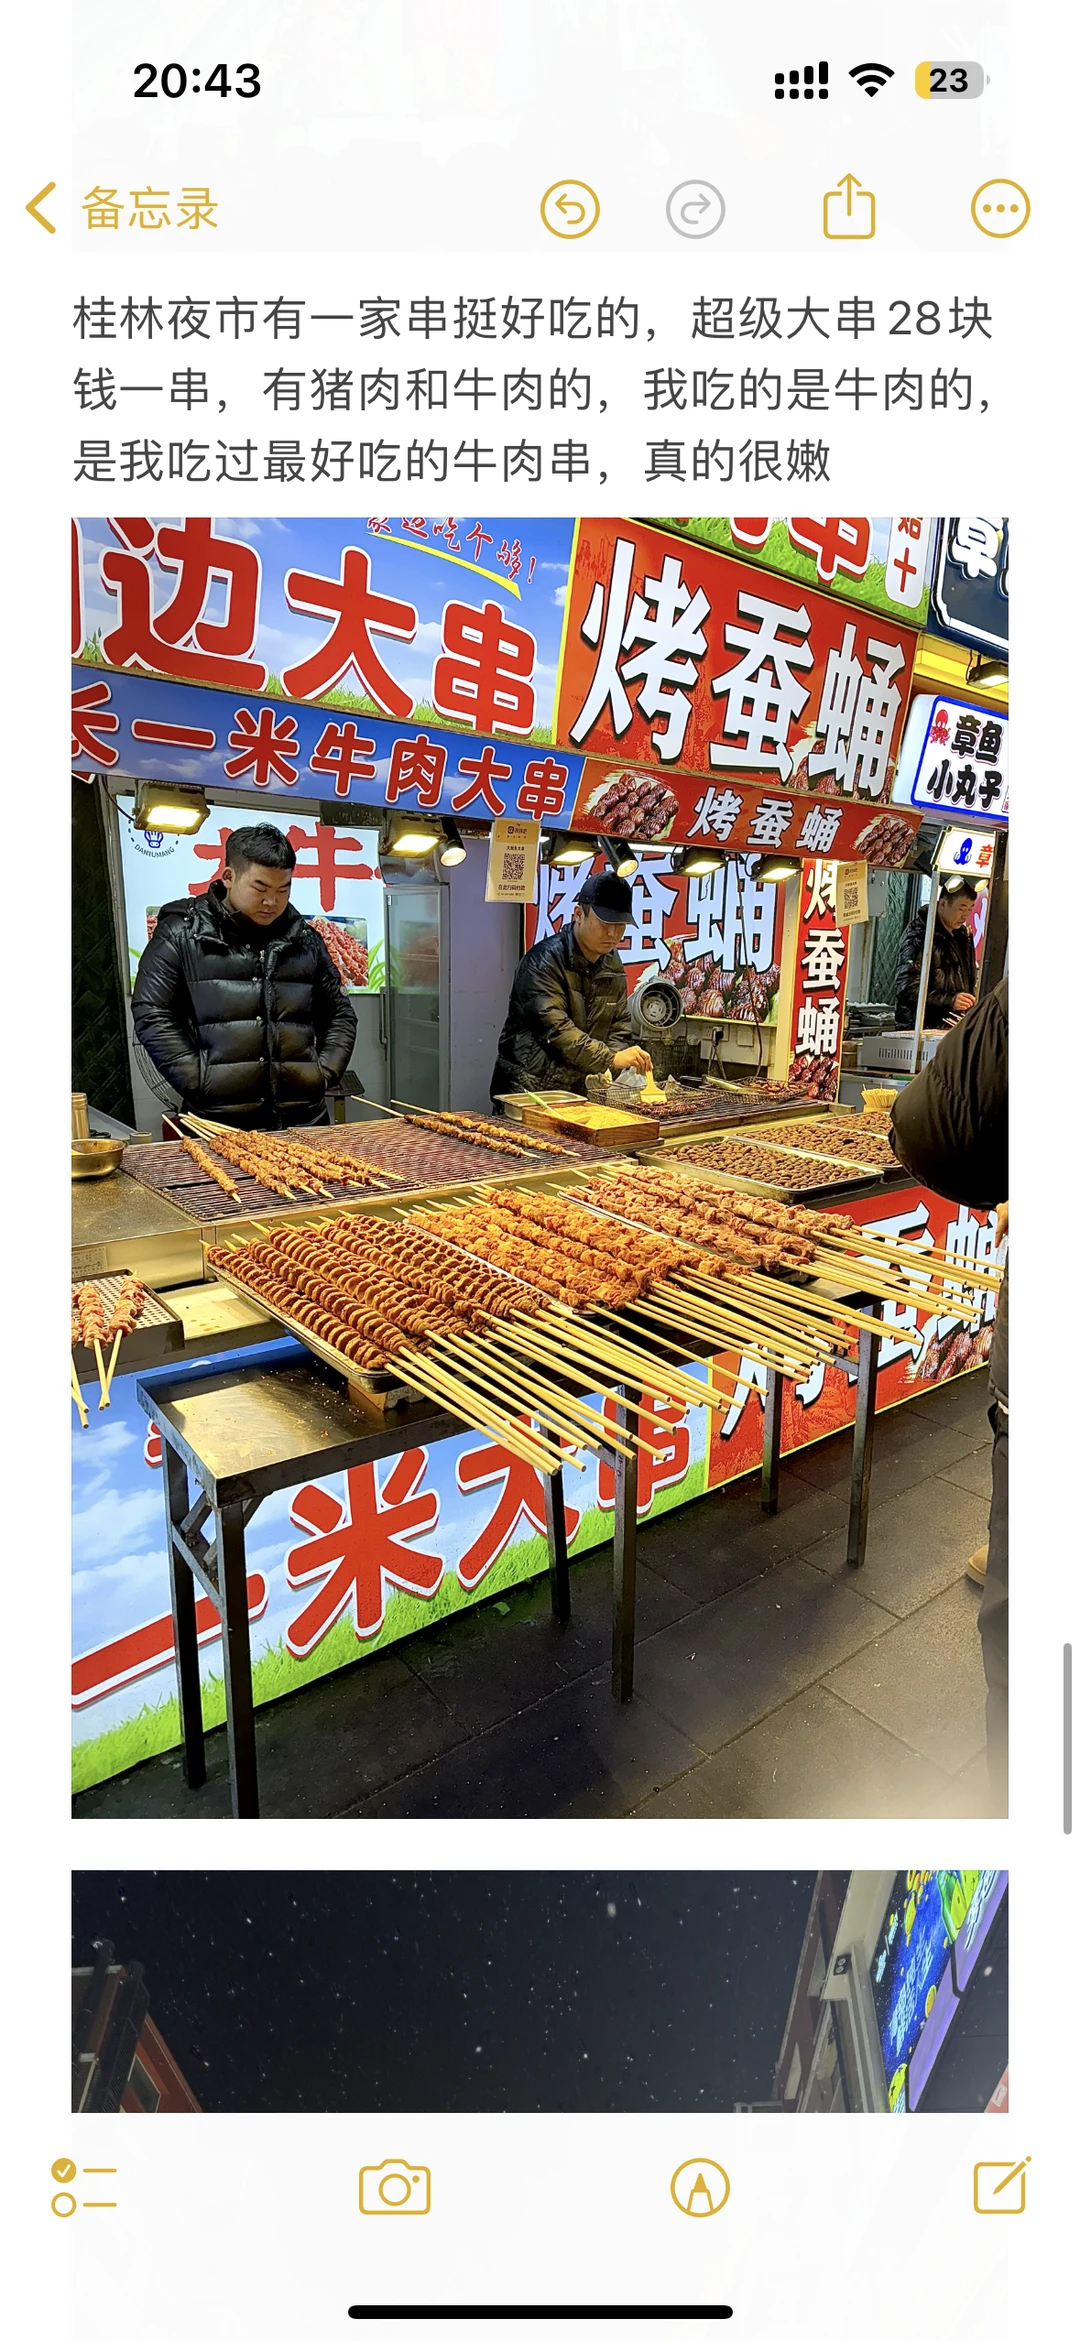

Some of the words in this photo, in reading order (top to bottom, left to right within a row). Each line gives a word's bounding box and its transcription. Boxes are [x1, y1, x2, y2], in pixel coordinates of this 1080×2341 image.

[71, 517, 537, 736] 边大串
[570, 537, 906, 798] 烤蚕蛹
[951, 714, 1003, 764] 章鱼
[926, 758, 1003, 809] 小丸子
[687, 785, 844, 855] 烤蚕蛹
